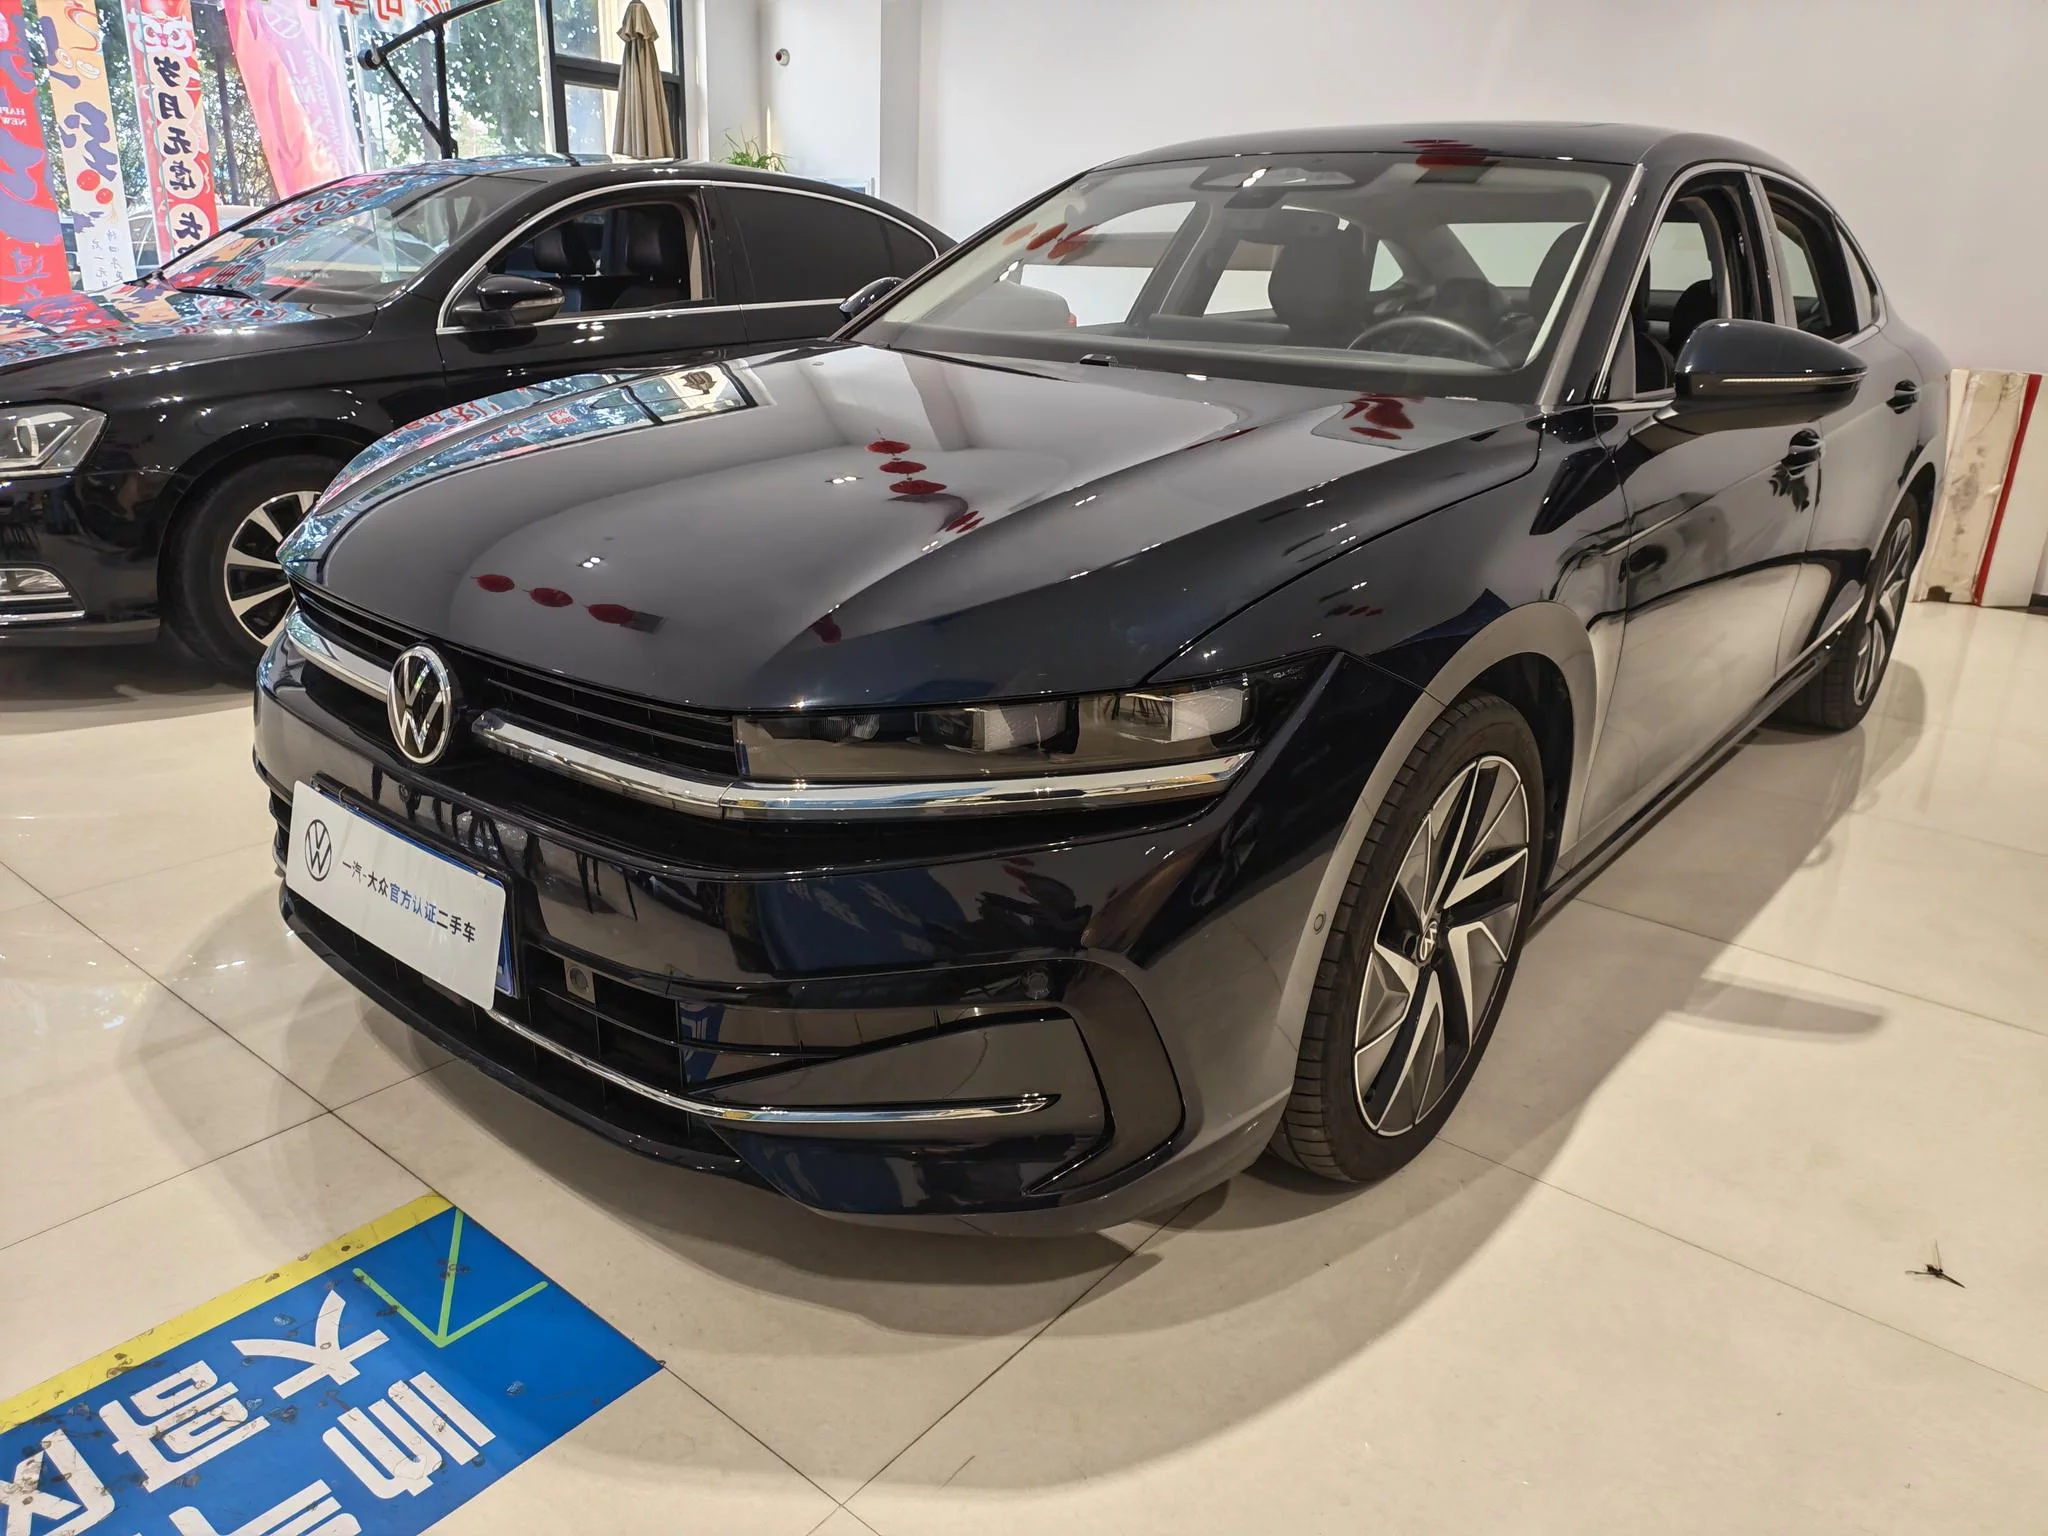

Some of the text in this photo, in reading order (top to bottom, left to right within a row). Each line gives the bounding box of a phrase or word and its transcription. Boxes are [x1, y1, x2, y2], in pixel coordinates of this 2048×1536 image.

[341, 858, 477, 944] 一汽-大众官方认证二手车
